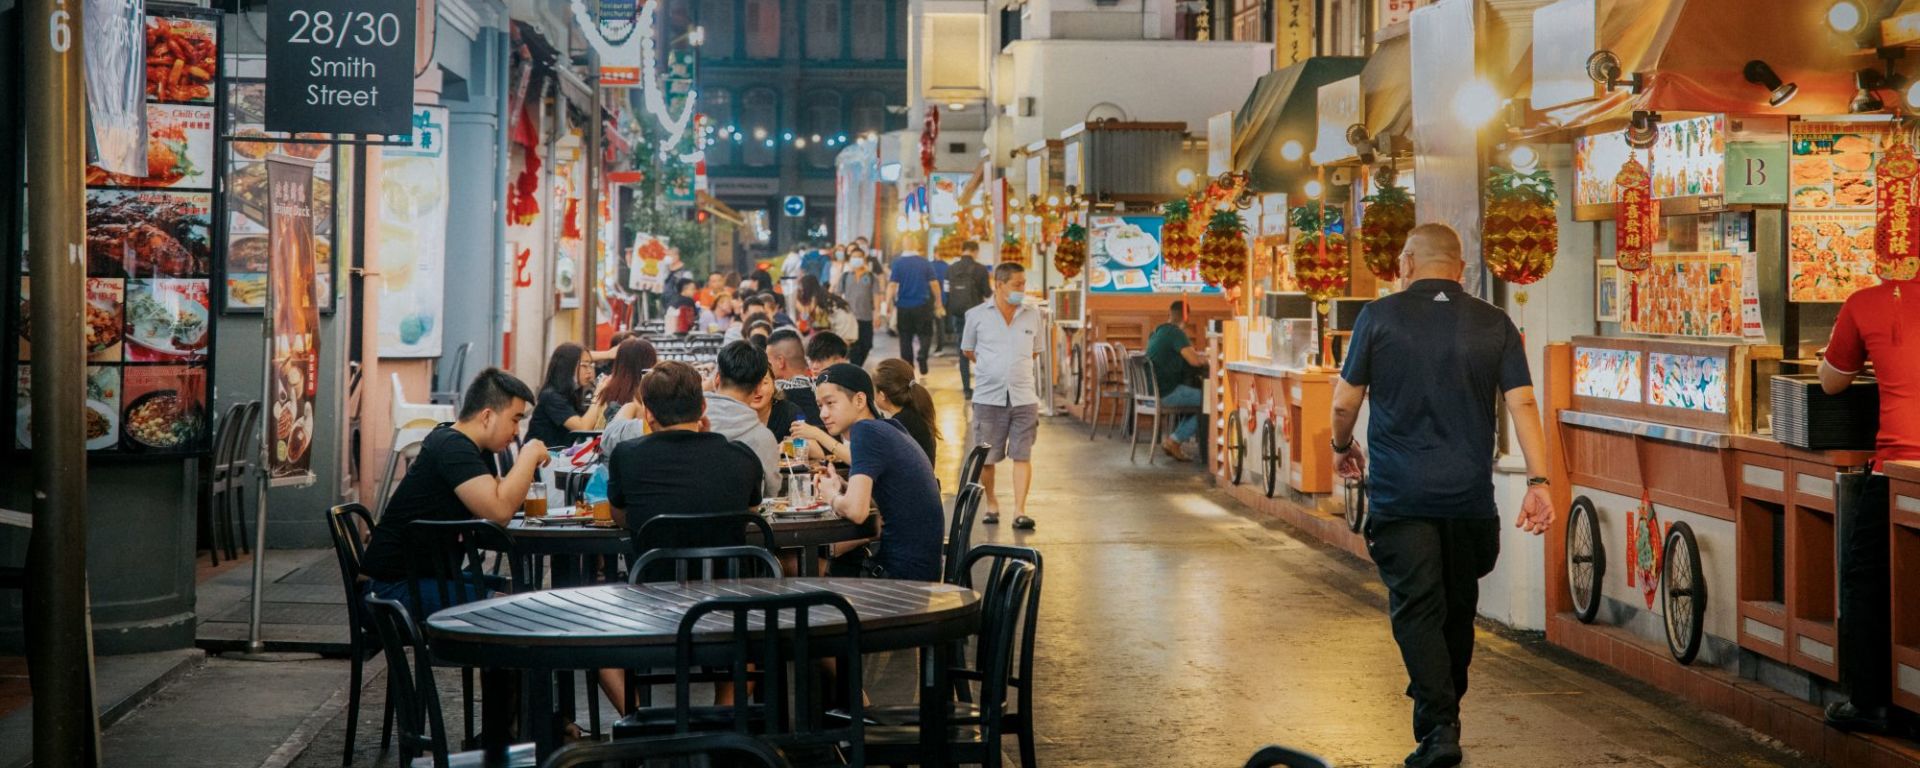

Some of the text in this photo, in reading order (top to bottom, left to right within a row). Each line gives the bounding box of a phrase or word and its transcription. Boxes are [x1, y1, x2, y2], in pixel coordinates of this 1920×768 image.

[288, 9, 400, 48] 28/30
[309, 55, 376, 78] Smith
[306, 84, 379, 106] Street
[195, 110, 210, 118] Crab
[293, 205, 311, 217] Duck
